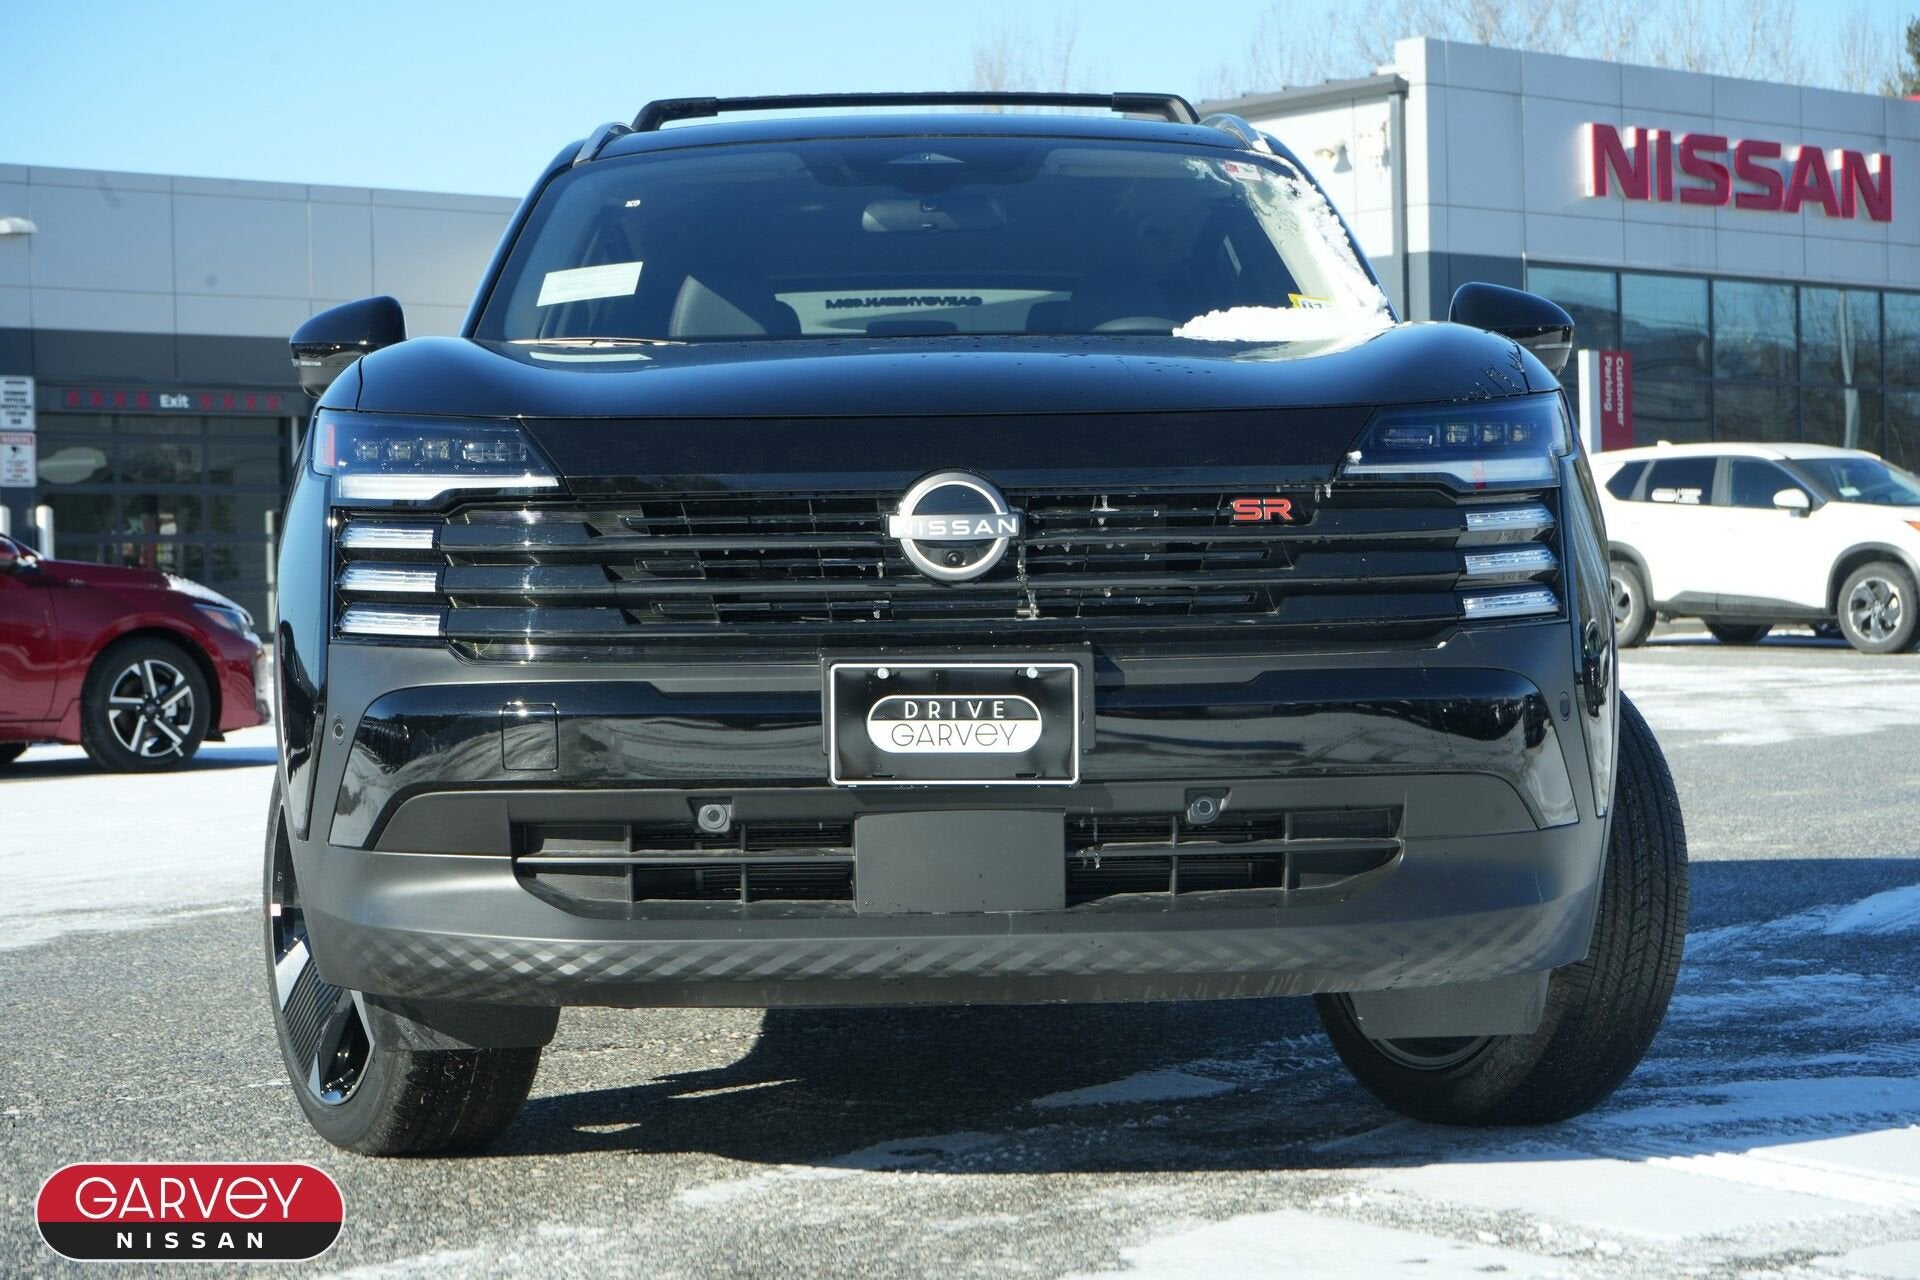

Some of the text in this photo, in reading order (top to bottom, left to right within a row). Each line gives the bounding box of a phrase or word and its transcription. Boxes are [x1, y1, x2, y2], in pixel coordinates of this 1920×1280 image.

[1584, 122, 1893, 222] NISSAN
[1603, 355, 1613, 412] Parking
[1615, 355, 1625, 428] Customer
[159, 393, 190, 408] Exit
[1232, 498, 1293, 520] SR
[894, 517, 1017, 536] NISSAN
[904, 700, 1005, 719] DRIVE
